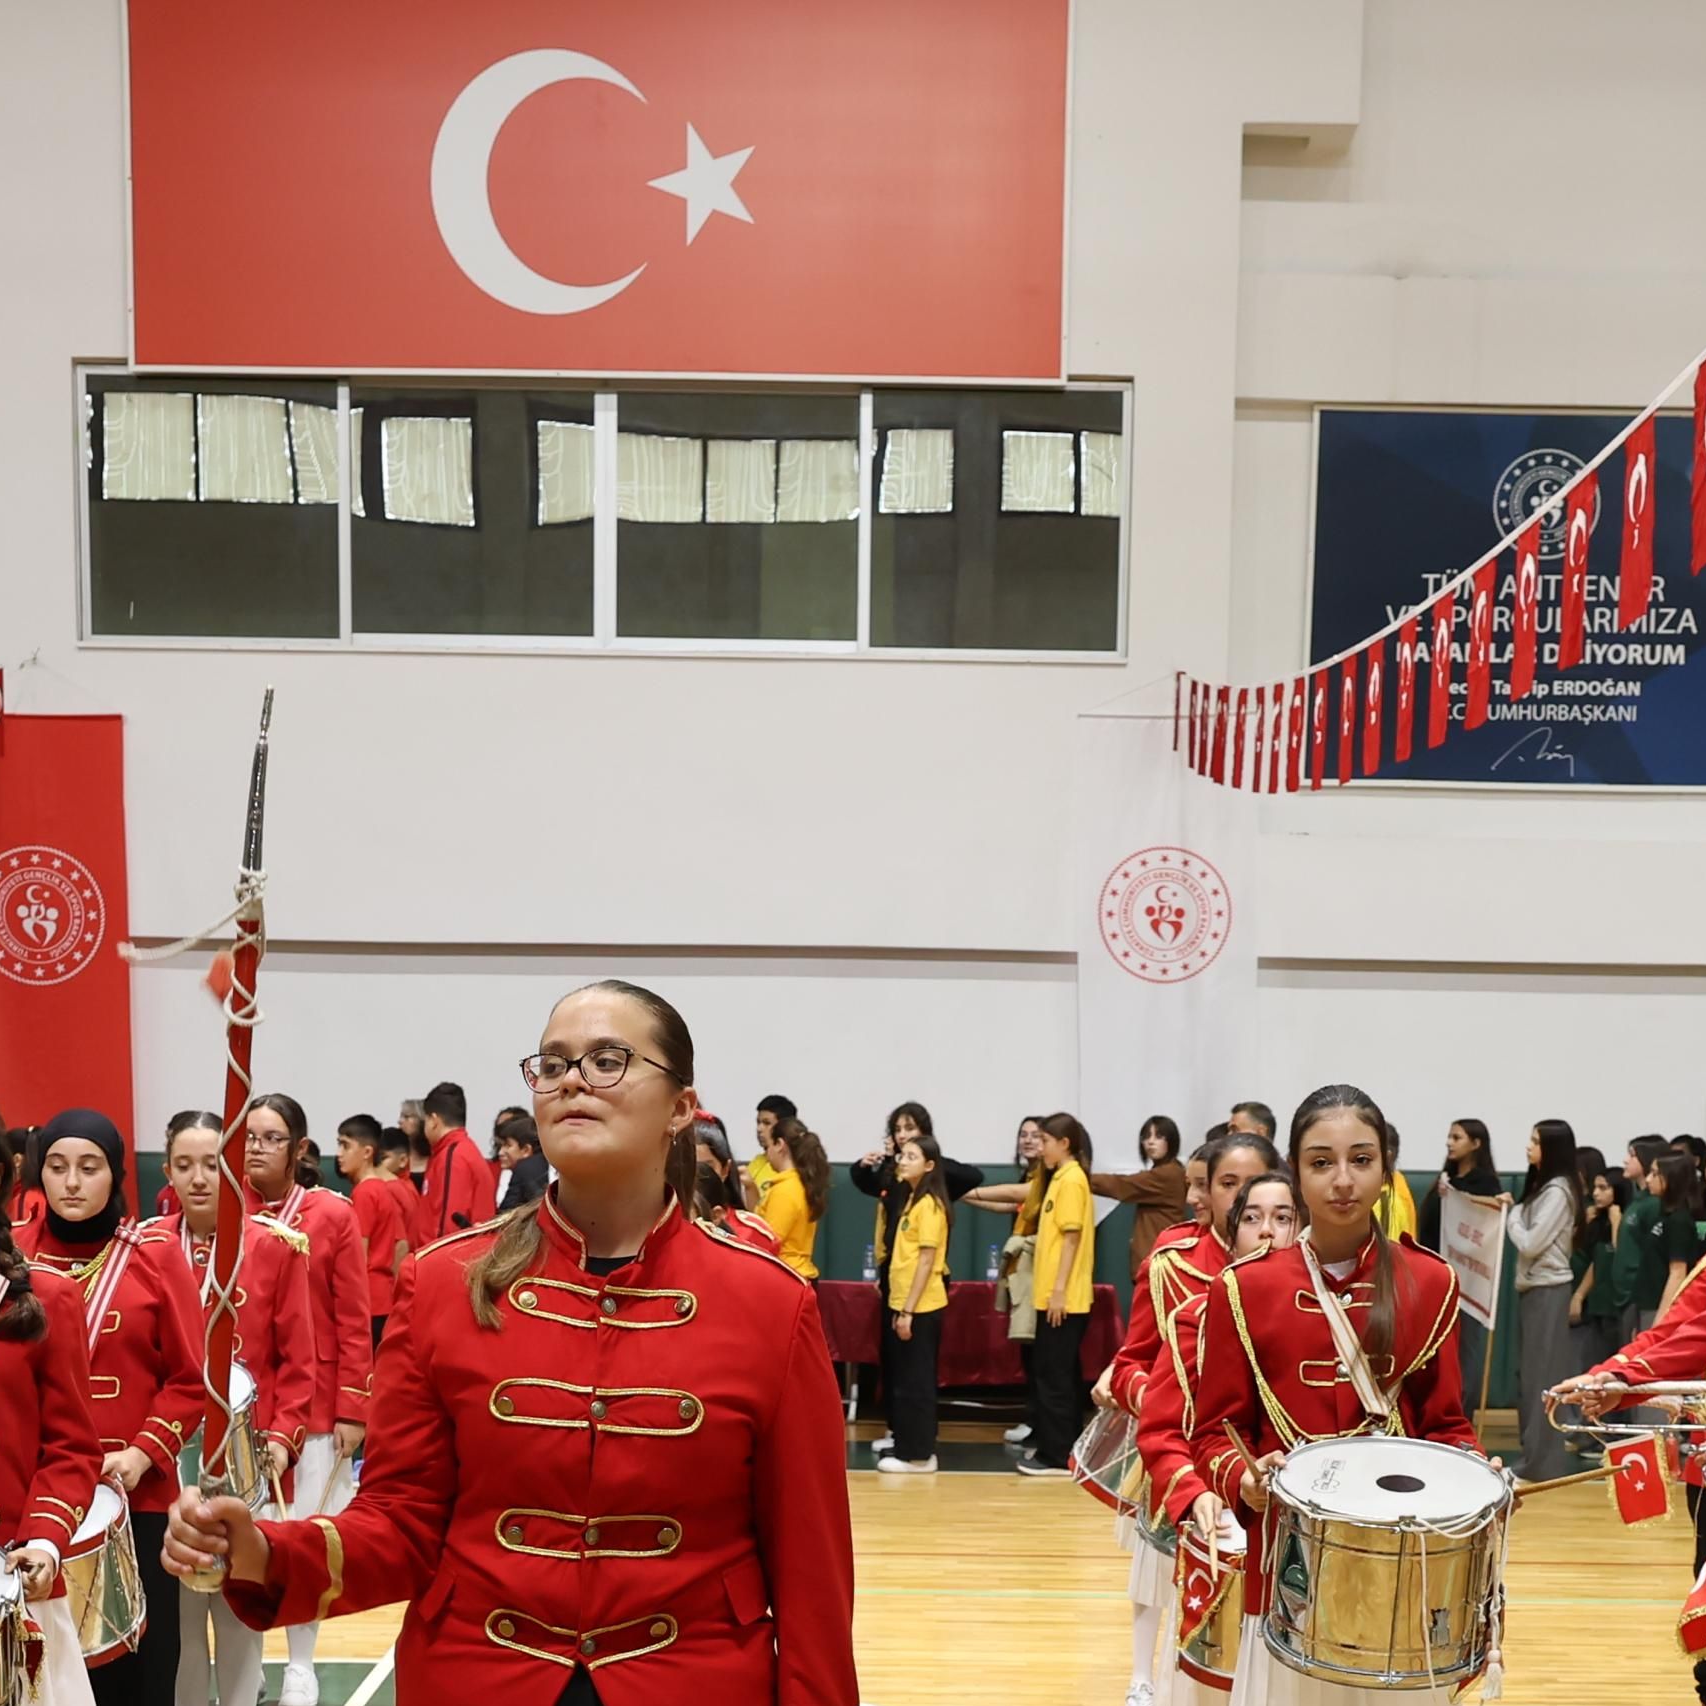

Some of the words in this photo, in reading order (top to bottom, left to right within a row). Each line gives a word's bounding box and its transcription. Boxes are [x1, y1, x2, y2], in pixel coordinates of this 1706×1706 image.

[1498, 574, 1665, 602] ATENR
[1543, 639, 1686, 666] DİYORUM
[1553, 678, 1641, 697] ERDOĞAN
[1487, 703, 1637, 725] UMHURBAŞKANI
